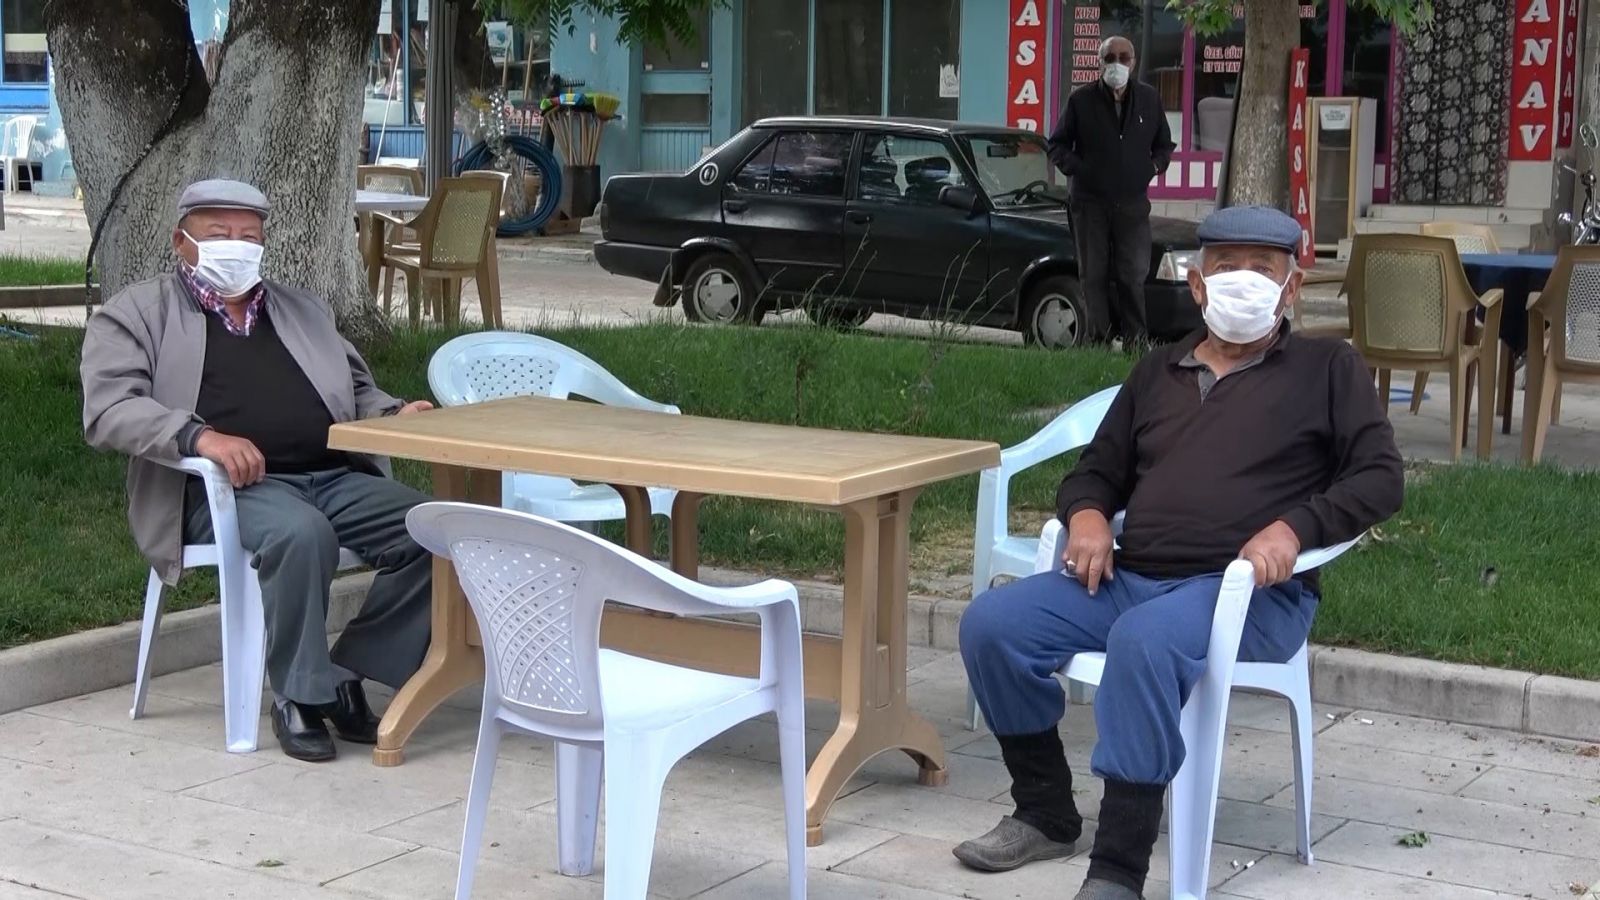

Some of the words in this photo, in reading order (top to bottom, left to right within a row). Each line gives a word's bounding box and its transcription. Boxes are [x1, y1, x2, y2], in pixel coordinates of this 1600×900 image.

[1074, 6, 1101, 20] KUZU
[1073, 23, 1101, 36] DANA
[1203, 45, 1224, 60] ÖZEL
[1517, 0, 1552, 152] ANAV
[1292, 59, 1310, 257] KASAP
